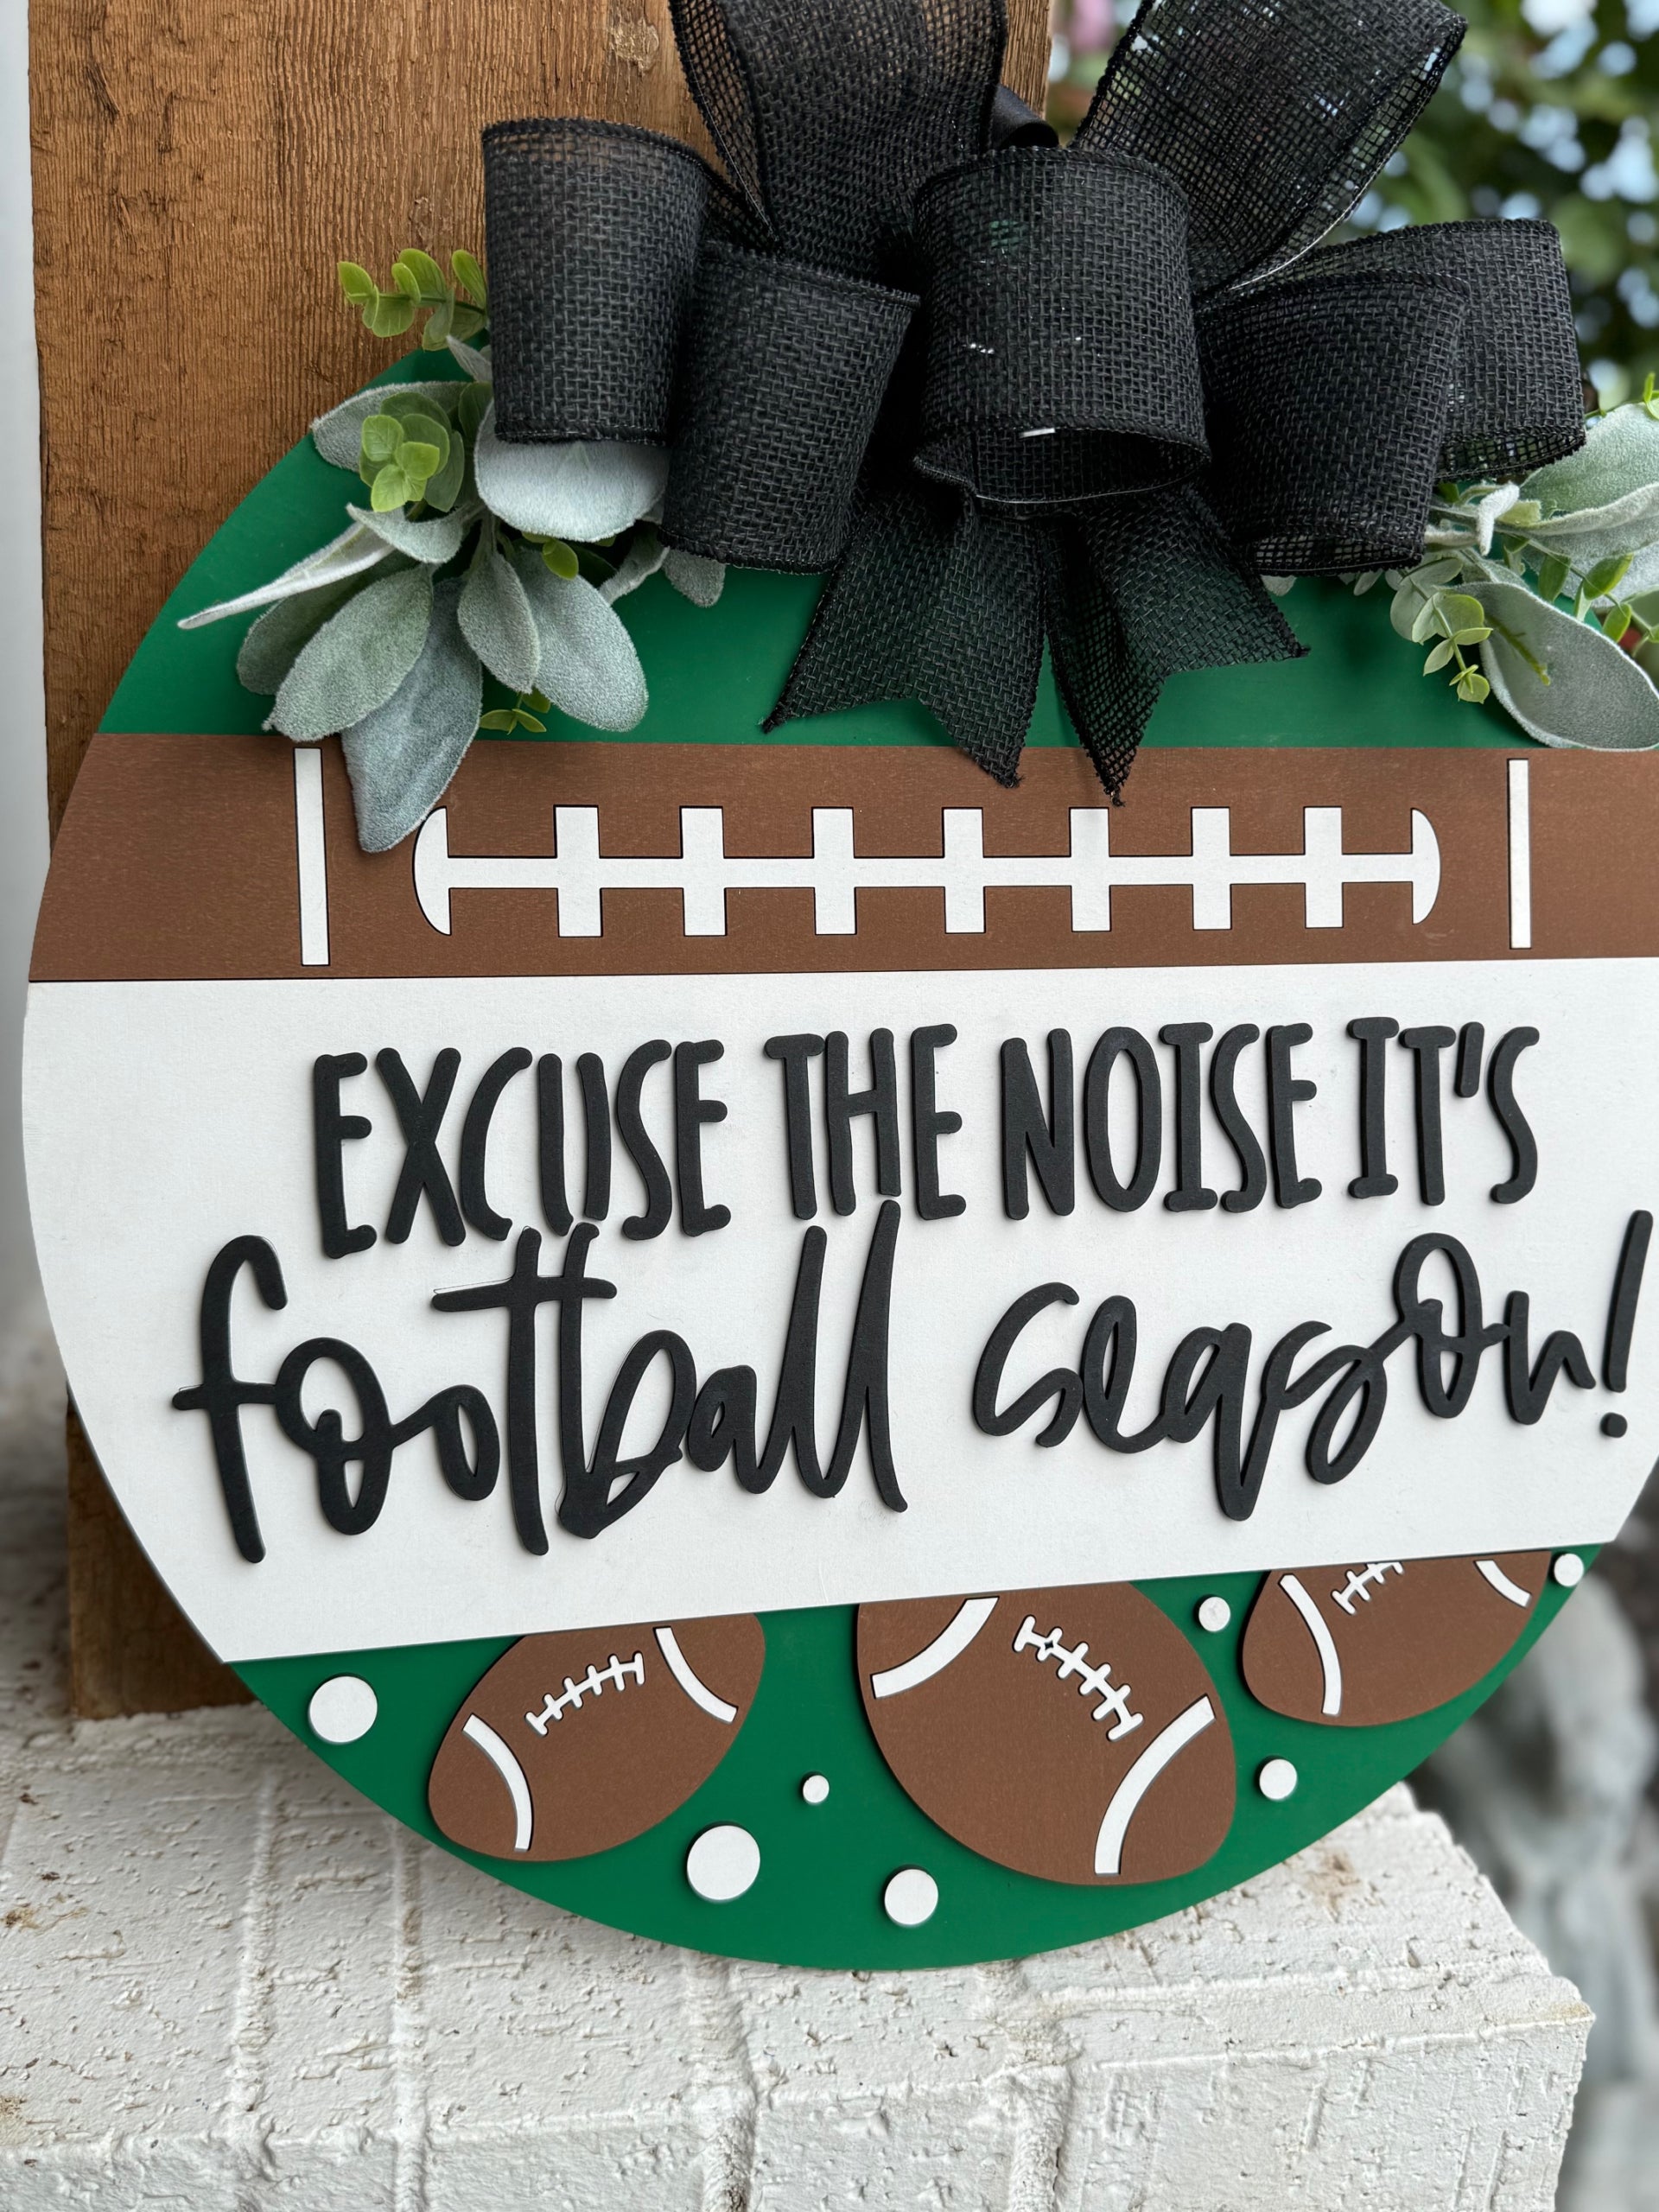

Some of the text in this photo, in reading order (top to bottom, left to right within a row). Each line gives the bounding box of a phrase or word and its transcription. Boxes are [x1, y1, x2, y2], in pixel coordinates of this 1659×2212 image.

[312, 1016, 1541, 1260] EXCUSE THE NOISE IT'S
[170, 1199, 1654, 1565] football season!
